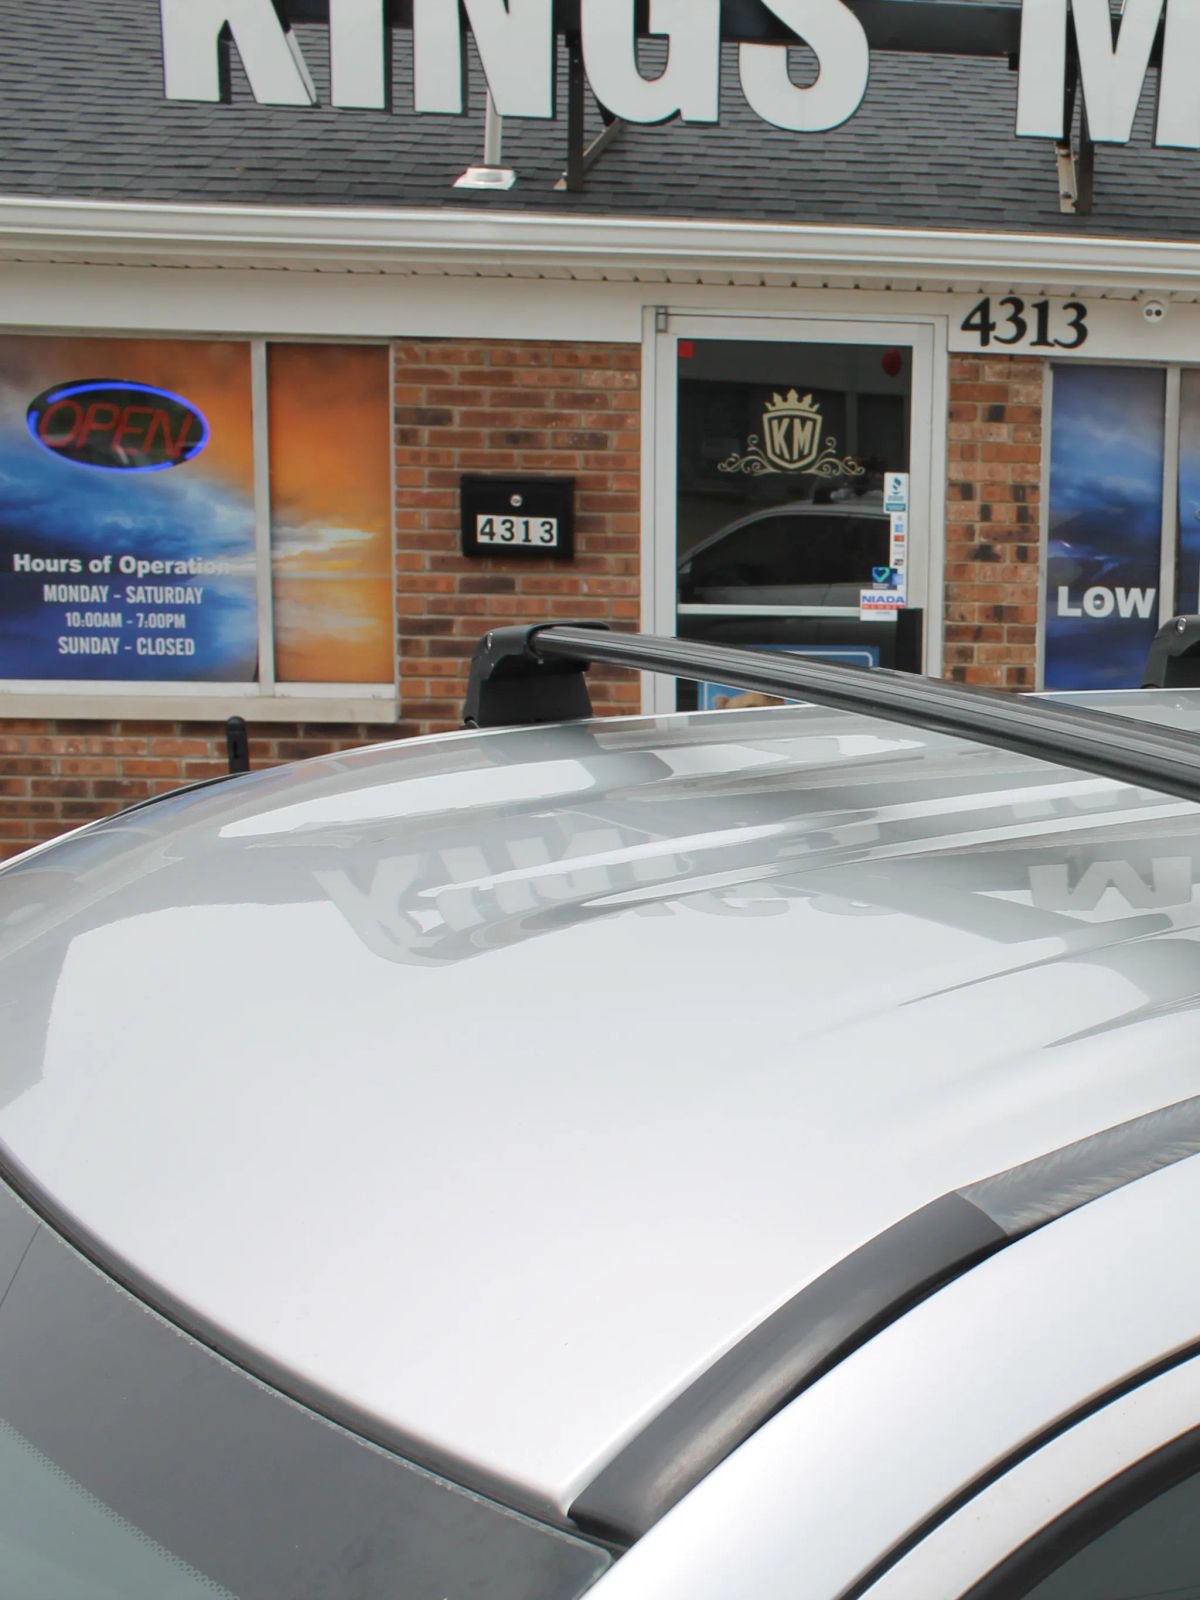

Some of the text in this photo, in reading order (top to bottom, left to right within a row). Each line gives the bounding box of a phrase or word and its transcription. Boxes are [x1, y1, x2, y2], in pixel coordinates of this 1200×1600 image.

[960, 296, 1088, 349] 4313
[38, 399, 193, 457] OPEN
[772, 418, 815, 460] KM
[480, 518, 554, 543] 4313
[13, 554, 232, 578] Hours of Operation
[43, 584, 109, 603] MONDAY
[126, 585, 203, 604] SATURDAY
[862, 595, 905, 604] NIADA
[1057, 586, 1156, 619] LOW
[65, 612, 122, 628] 10:00AM
[136, 613, 186, 629] 7:00PM
[58, 636, 120, 654] SUNDAY
[136, 638, 195, 656] CLOSED
